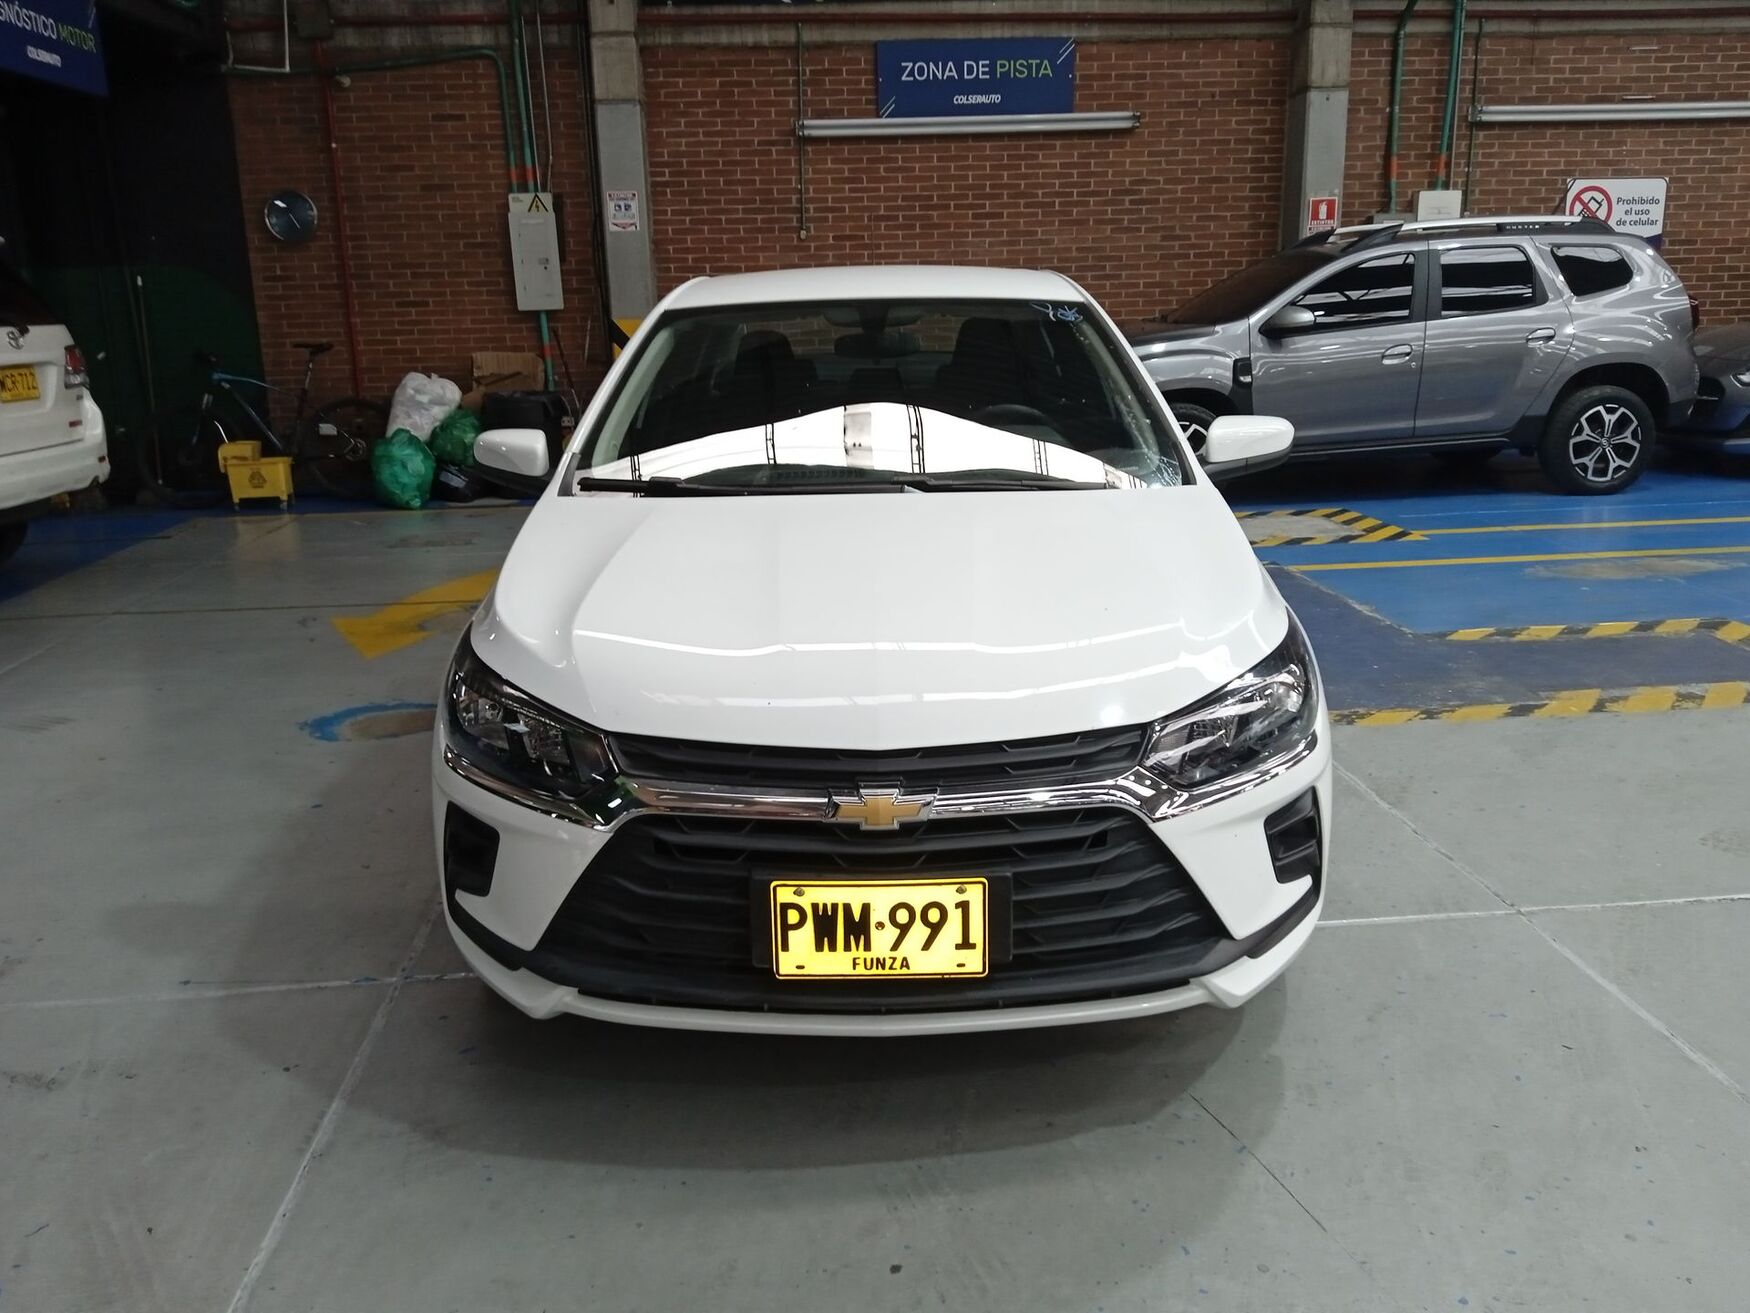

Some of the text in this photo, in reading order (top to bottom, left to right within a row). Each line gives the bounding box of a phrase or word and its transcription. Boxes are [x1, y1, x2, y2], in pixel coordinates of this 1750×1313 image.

[58, 23, 97, 53] MOTOR
[901, 59, 1053, 81] ZONA DE PISTA
[953, 94, 1002, 105] COLSERAUTO
[1616, 196, 1660, 206] Prohibido
[1624, 207, 1650, 216] el uso
[1616, 217, 1659, 227] de celular
[852, 956, 911, 971] FUNZA
